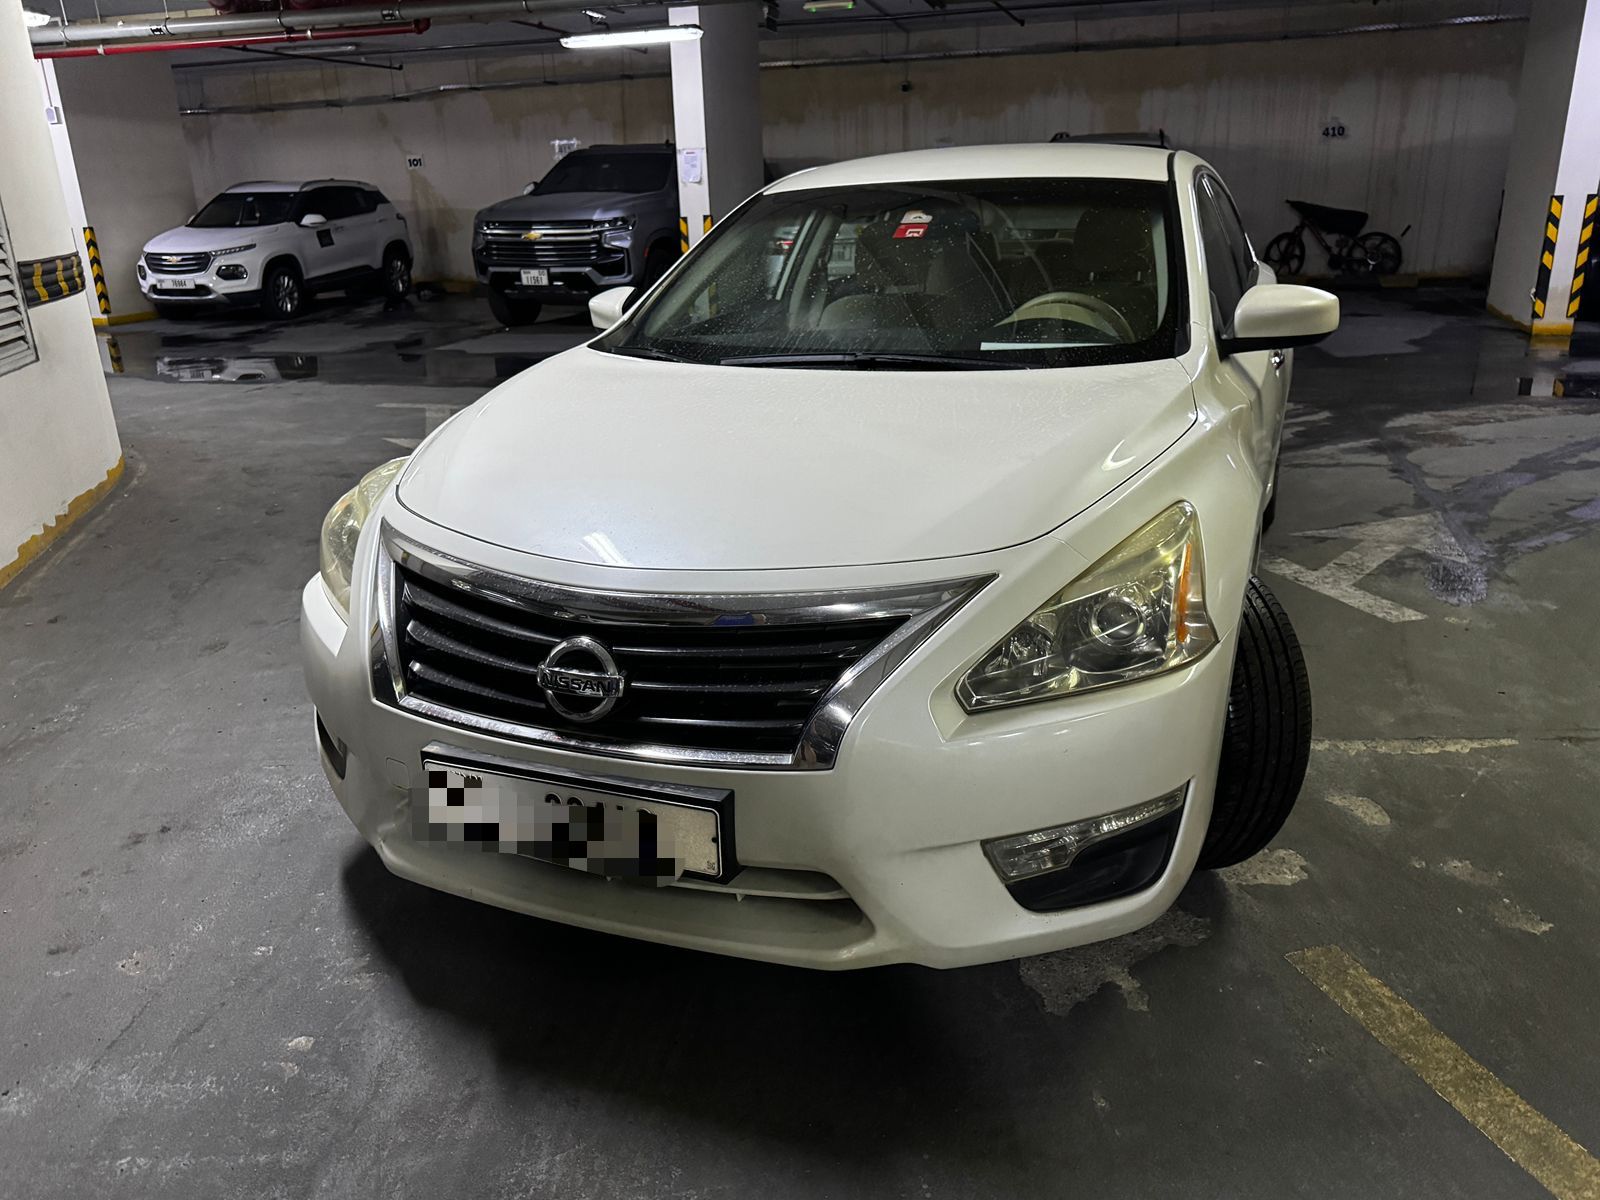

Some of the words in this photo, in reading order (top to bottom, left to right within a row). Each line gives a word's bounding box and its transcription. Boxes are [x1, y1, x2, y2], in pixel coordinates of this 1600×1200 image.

[1322, 126, 1345, 137] 410
[408, 158, 422, 167] 101
[541, 673, 611, 694] NISSAN
